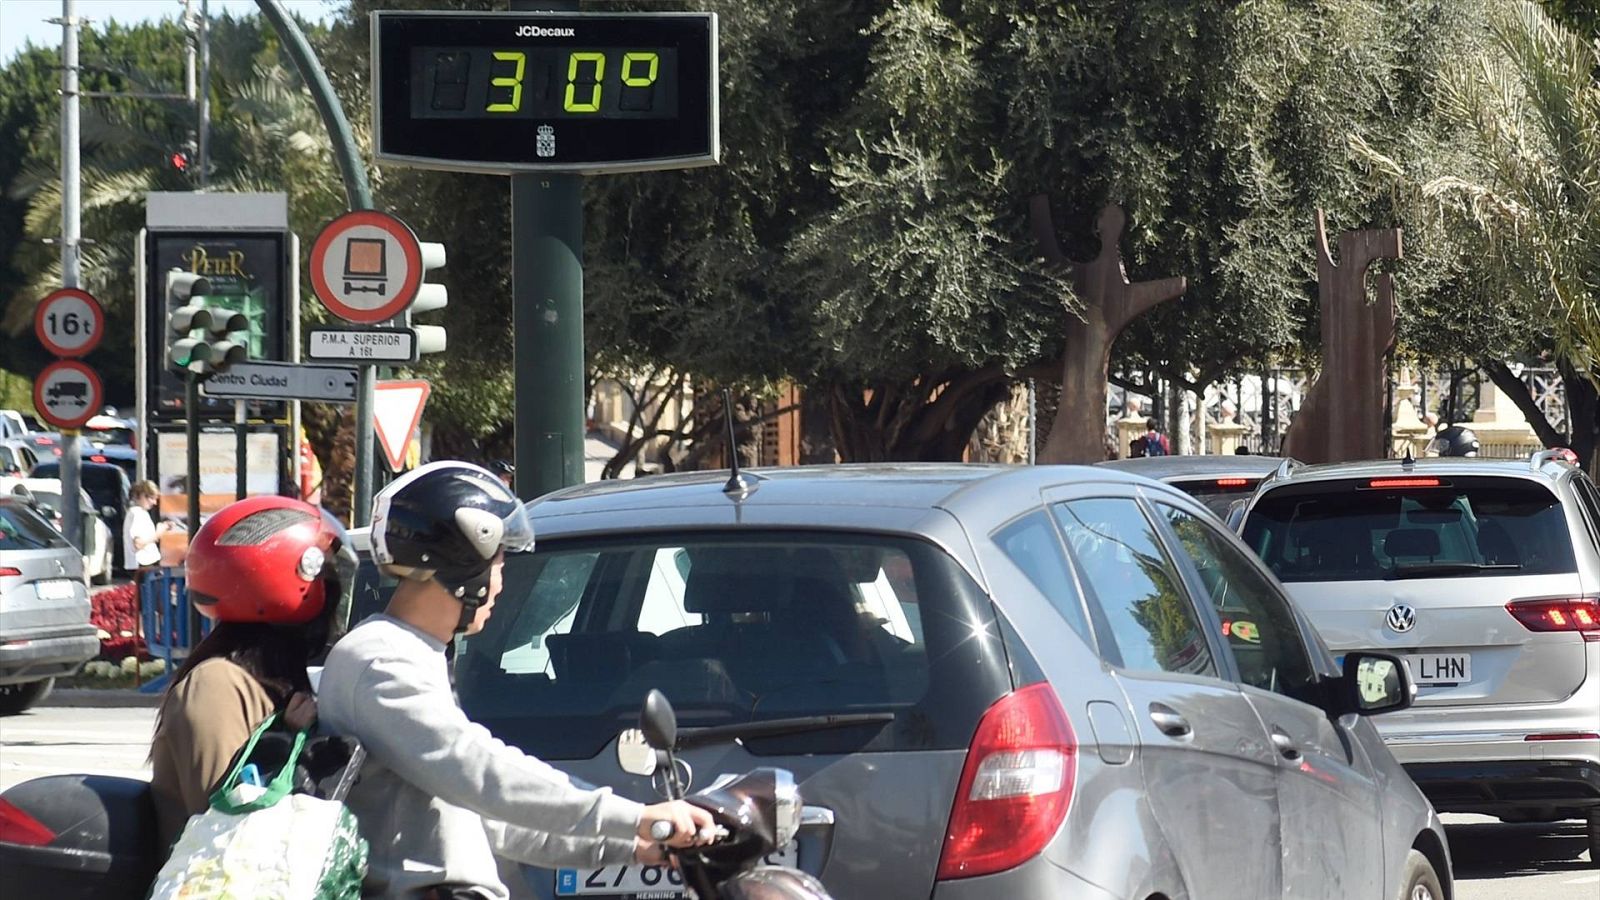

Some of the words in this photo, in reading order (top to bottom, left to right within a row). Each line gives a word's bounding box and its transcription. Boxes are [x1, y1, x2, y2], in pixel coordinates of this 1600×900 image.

[515, 25, 575, 37] JCDecaux
[321, 333, 348, 344] P.M.A.
[353, 334, 400, 346] SUPERIOR
[349, 346, 355, 356] A
[209, 373, 246, 385] Centro
[250, 373, 288, 387] Ciudad
[1420, 657, 1464, 679] LHN
[563, 874, 572, 886] E
[637, 891, 675, 900] HENNING
